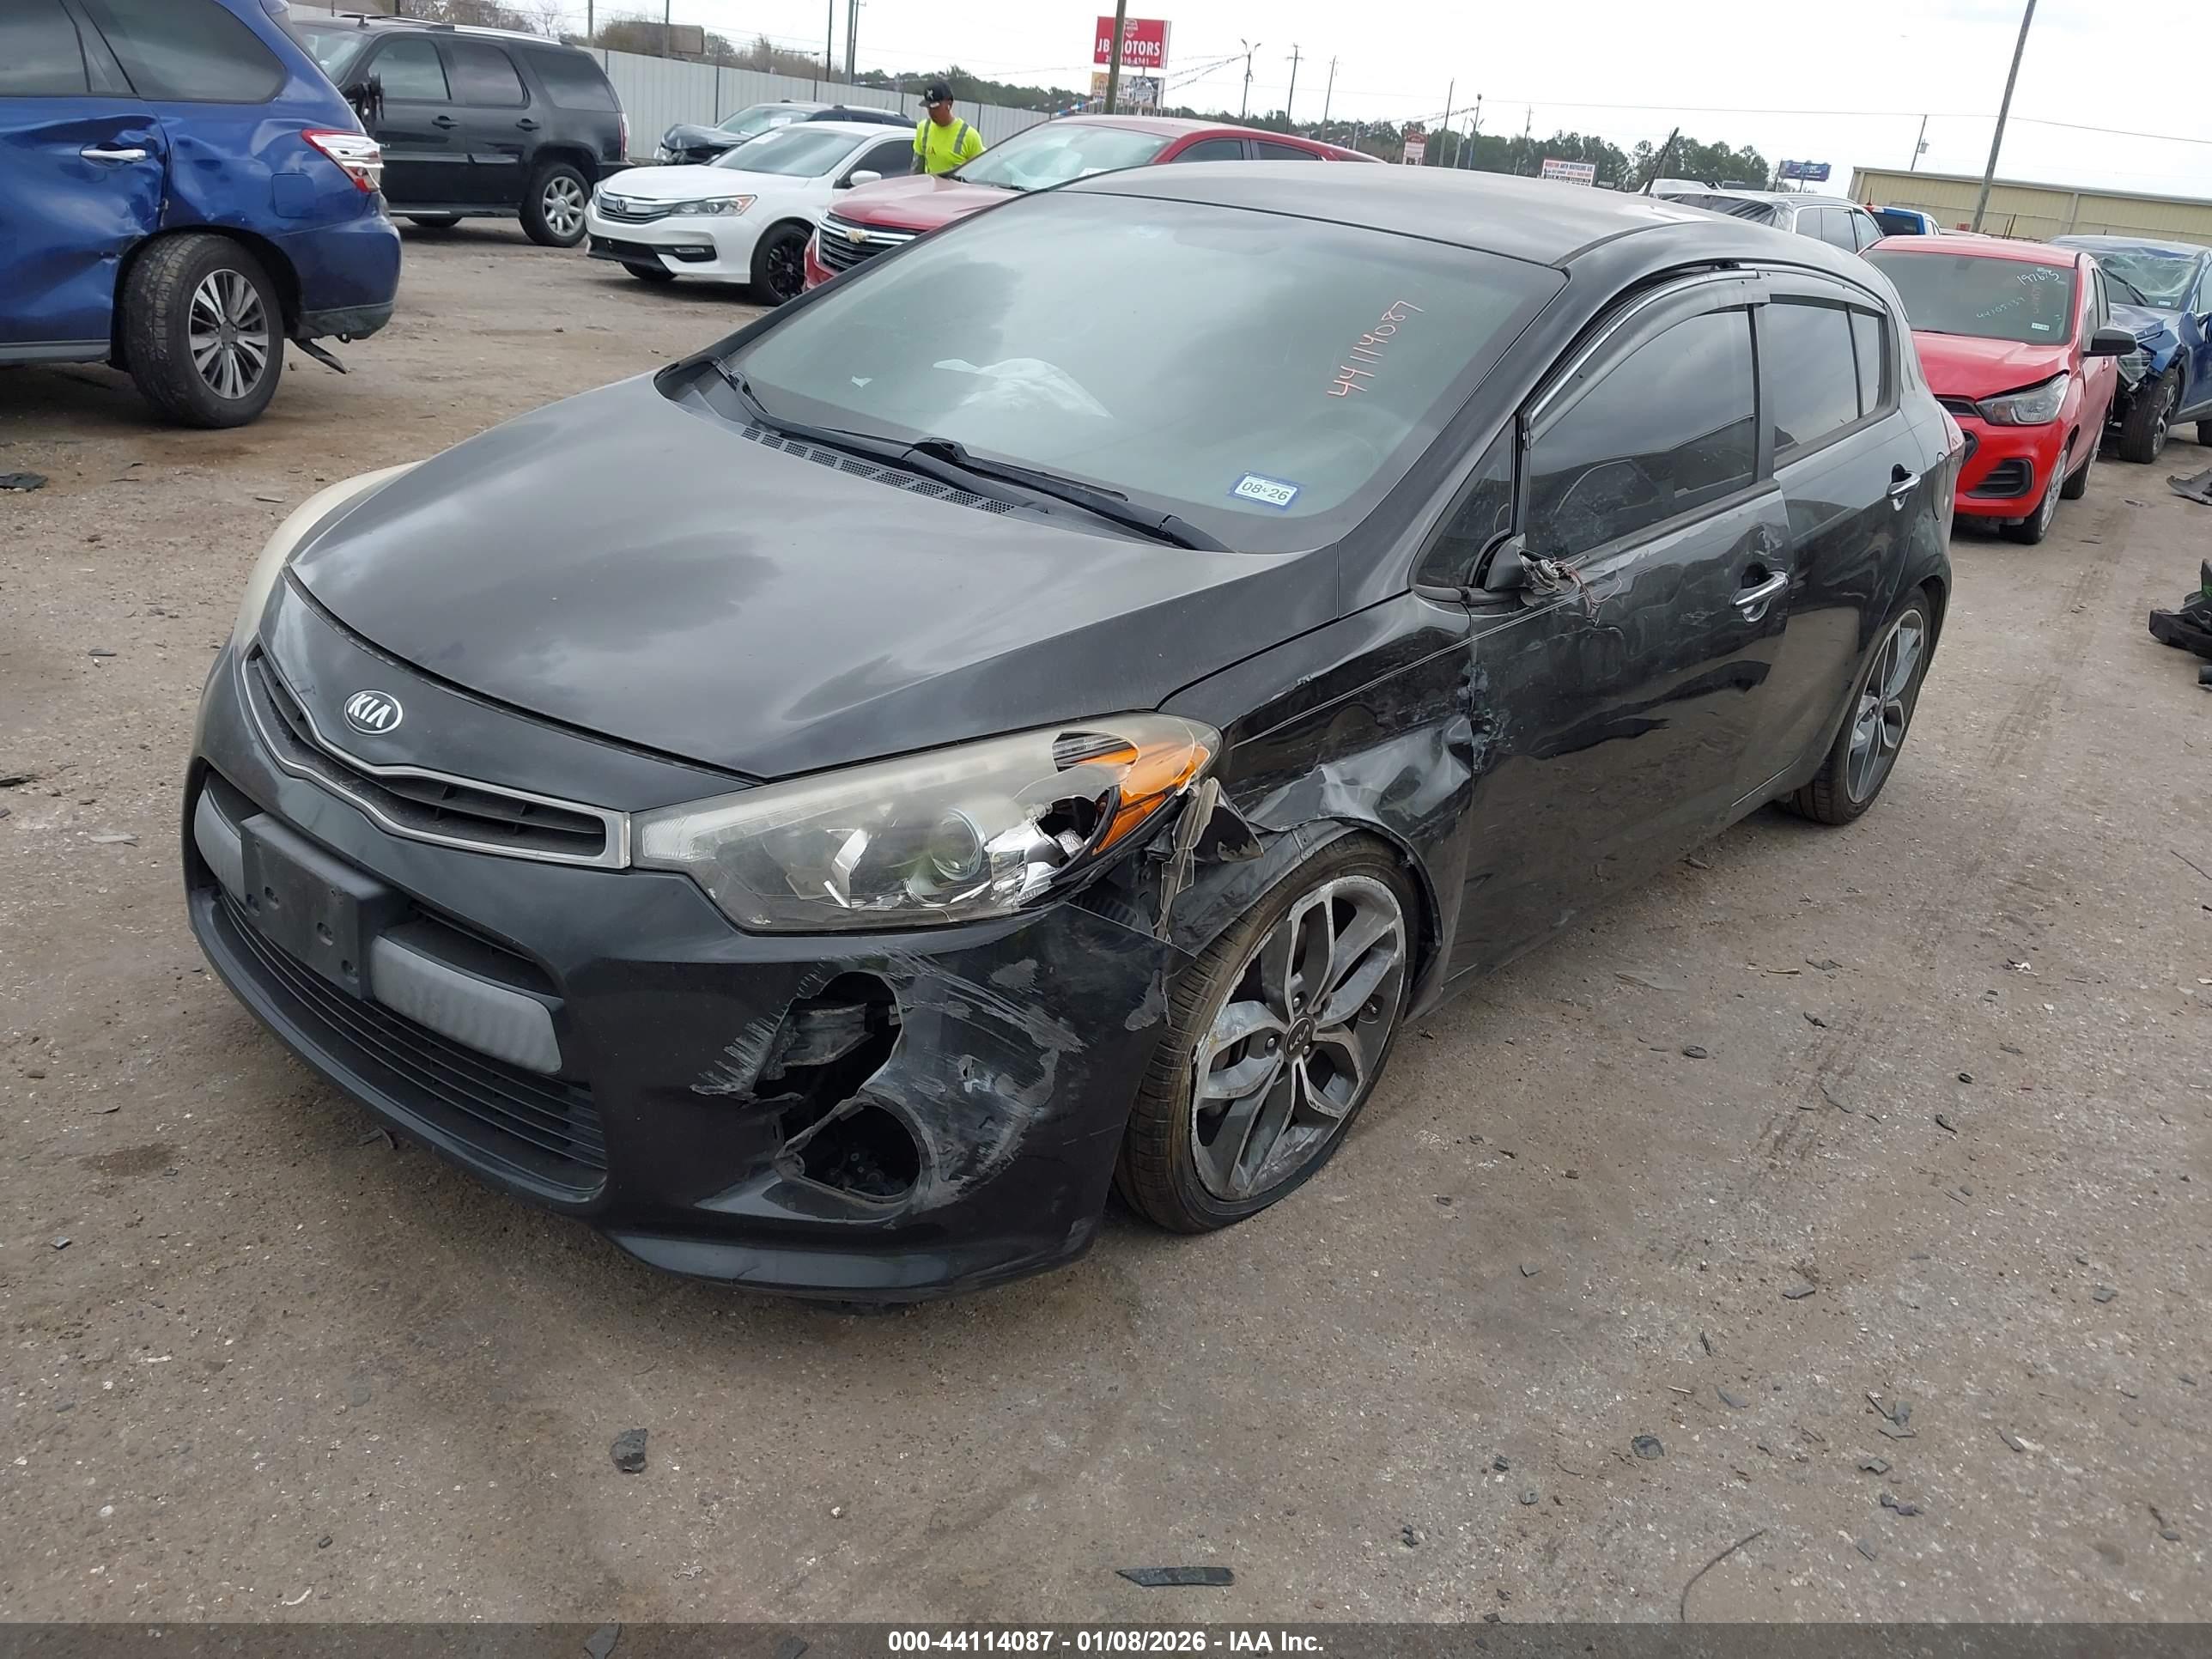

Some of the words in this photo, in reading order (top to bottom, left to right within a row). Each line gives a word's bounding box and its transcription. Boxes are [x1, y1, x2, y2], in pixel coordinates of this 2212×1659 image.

[1097, 38, 1110, 53] JB
[1121, 39, 1161, 57] OTORS
[1327, 301, 1425, 396] 44114087
[348, 693, 392, 728] KIA
